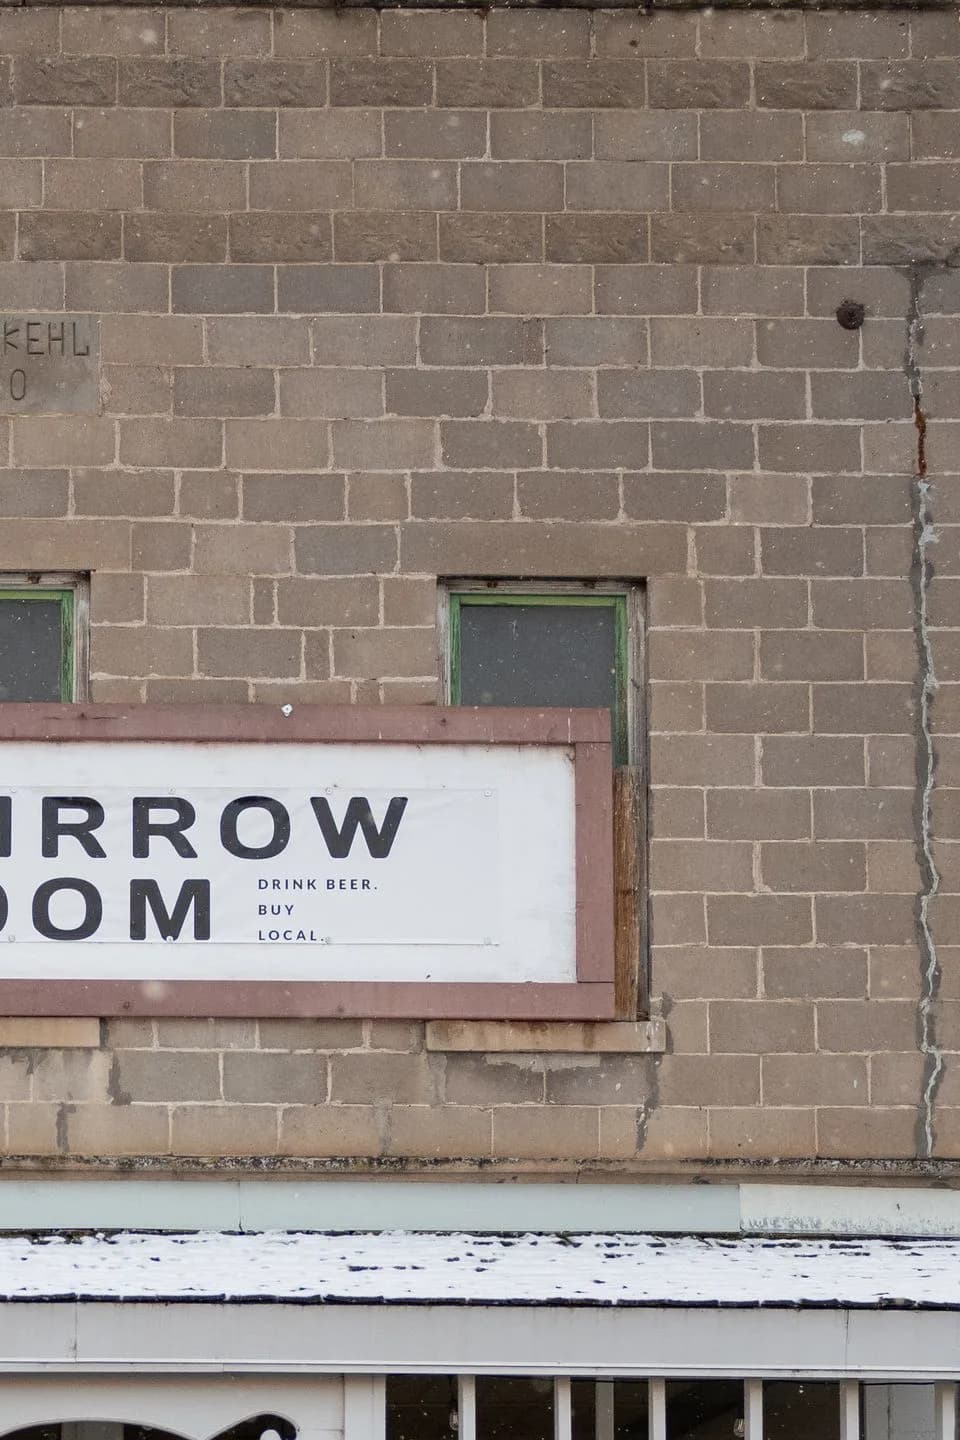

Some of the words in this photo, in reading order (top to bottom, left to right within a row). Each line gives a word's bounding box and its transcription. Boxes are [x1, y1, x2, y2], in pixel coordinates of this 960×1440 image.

[3, 320, 89, 356] KEHL
[258, 879, 317, 890] DRINK
[326, 879, 378, 890] BEER.
[258, 904, 294, 916] BUY
[258, 929, 325, 942] LOCAL.
